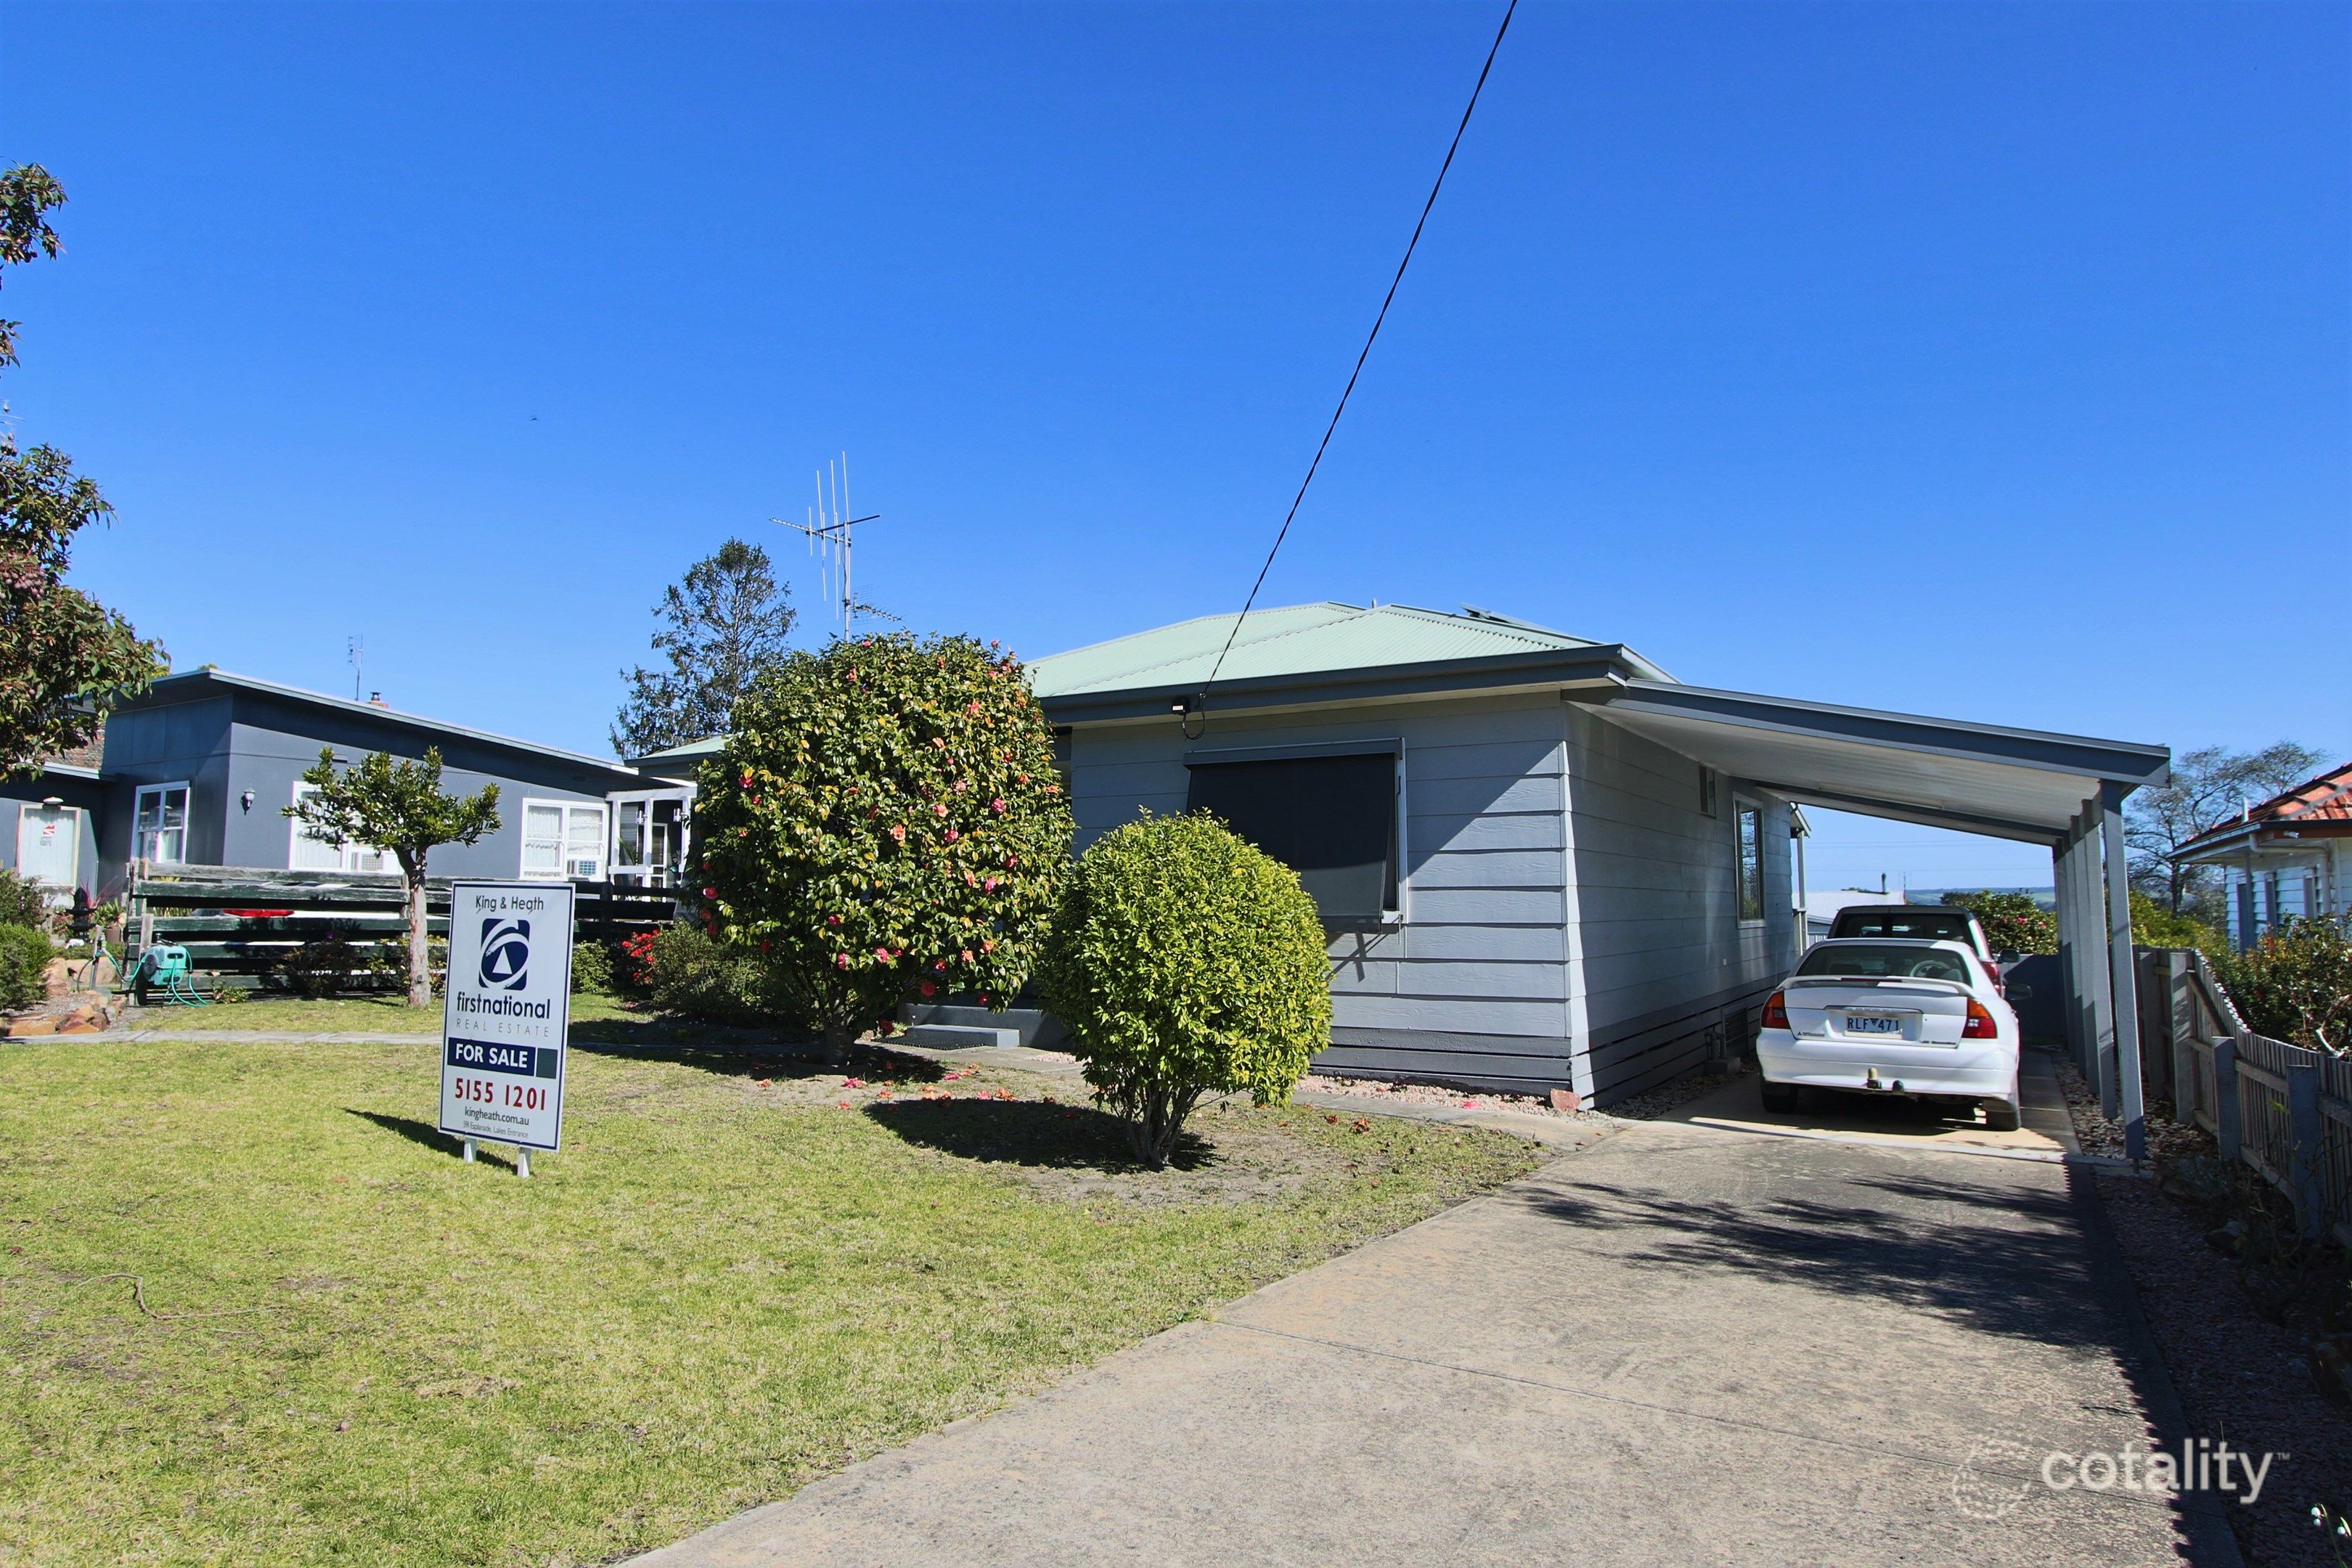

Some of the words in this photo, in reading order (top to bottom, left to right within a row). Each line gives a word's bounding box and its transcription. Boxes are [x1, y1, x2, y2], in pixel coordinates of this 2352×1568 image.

[475, 895, 497, 912] King
[500, 897, 507, 908] &
[511, 897, 544, 910] Heath
[457, 992, 550, 1019] firstnational
[456, 1018, 487, 1031] REAL
[498, 1022, 549, 1037] ESTATE
[1847, 1018, 1869, 1029] RLF
[1878, 1019, 1899, 1031] 471
[455, 1043, 483, 1063] FOR
[489, 1048, 528, 1068] SALE
[455, 1078, 494, 1103] 5155
[505, 1085, 546, 1111] 1201
[465, 1106, 529, 1125] kingheath.com.au
[494, 1126, 507, 1135] Lakes
[507, 1128, 528, 1138] Entrance
